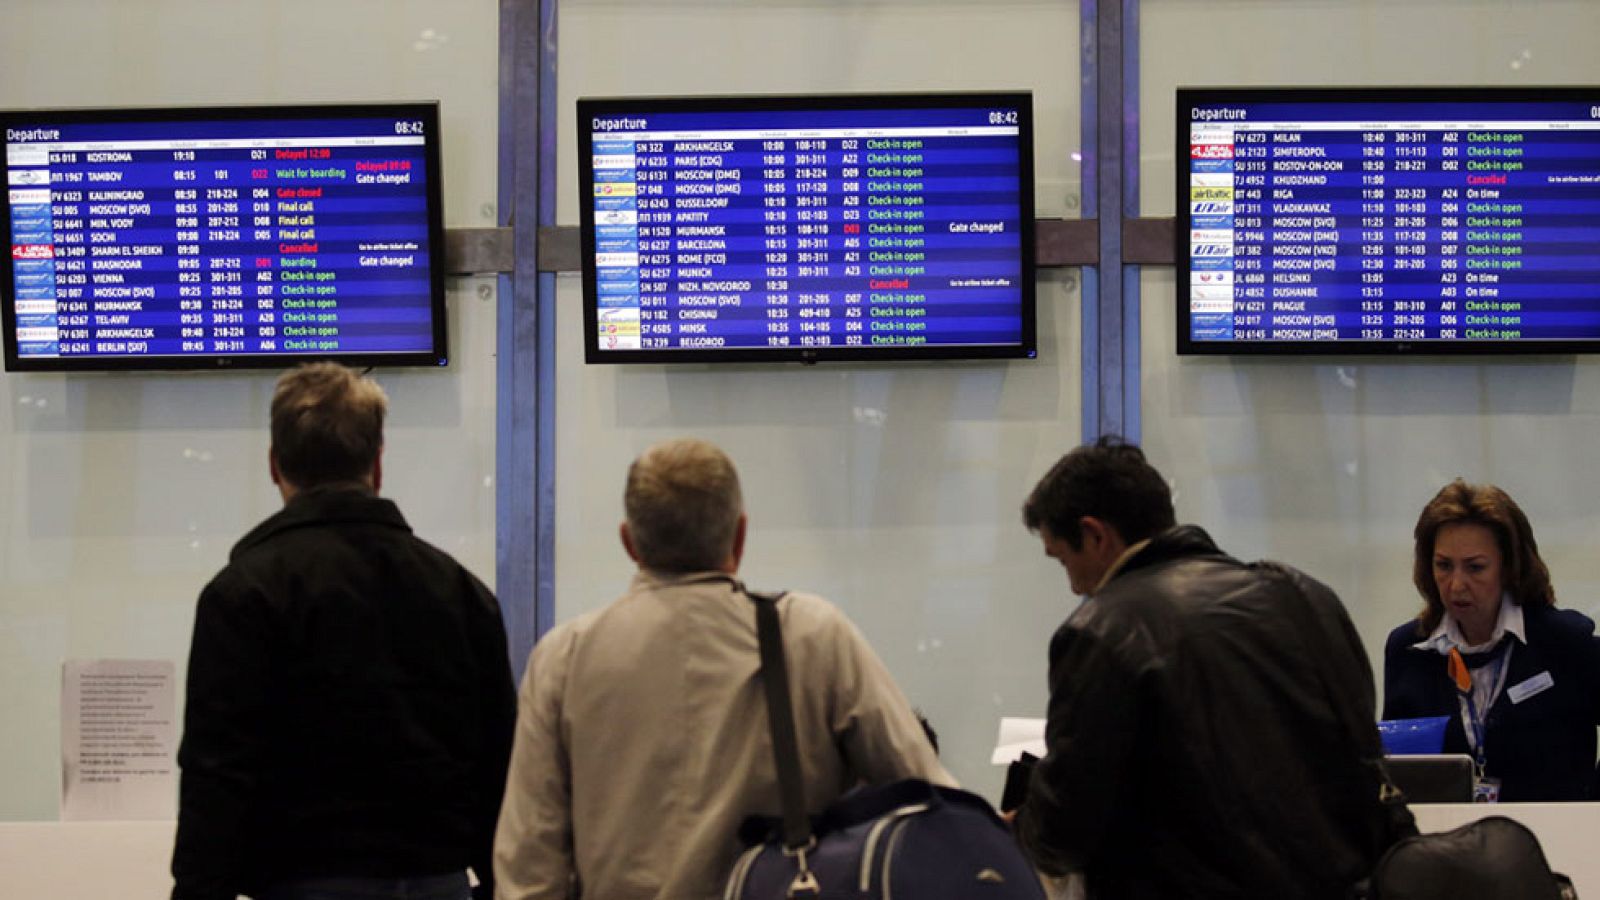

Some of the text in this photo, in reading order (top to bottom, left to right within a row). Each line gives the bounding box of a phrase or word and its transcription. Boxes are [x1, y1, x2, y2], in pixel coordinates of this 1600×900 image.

[989, 112, 1018, 124] 08:42
[1191, 108, 1247, 121] Departure
[395, 122, 423, 134] 08:42
[592, 118, 647, 131] Departure
[7, 129, 59, 142] Departure
[1233, 133, 1246, 143] FV
[1273, 133, 1301, 143] MILAN
[1363, 132, 1385, 143] 10:40
[1395, 132, 1426, 143] 301-311
[1442, 132, 1459, 143] A02
[1467, 132, 1502, 143] Check-in
[1502, 133, 1524, 143] open
[674, 141, 734, 152] ARKHANGELSK
[763, 141, 785, 151] 10:00
[842, 139, 858, 150] D22
[866, 139, 901, 150] Check-in
[901, 140, 923, 150] open
[1273, 146, 1326, 157] SIMFEROPOL
[87, 152, 132, 163] KOSTROMA
[251, 149, 267, 160] D21
[275, 149, 308, 160] Delayed
[674, 156, 698, 166] PARIS
[842, 153, 858, 164] A22
[866, 153, 901, 164] Check-in
[902, 154, 923, 164] open
[355, 161, 389, 172] Delayed
[1273, 160, 1523, 171] ROSTOV-ON-DON Check-in open
[87, 167, 346, 182] TAMBOV 101 Wait for boarding
[355, 173, 410, 184] Gate changed
[675, 169, 740, 181] MOSCOW (DME)
[1467, 175, 1507, 185] Cancelled
[675, 181, 923, 195] MOSCOW (DME) Check-in open
[1193, 189, 1231, 199] airBaltic
[1273, 188, 1500, 200] RIGA 11:00 322-323 A24 On time
[88, 188, 322, 201] KALININGRAD Gate closed
[89, 204, 128, 215] MOSCOW
[277, 201, 298, 212] Final
[298, 201, 314, 212] call
[675, 198, 728, 208] DUSSELDORF
[1273, 202, 1523, 214] VLADIKAVKAZ Check-in open
[868, 209, 902, 220] Check-in
[902, 210, 924, 220] open
[90, 219, 110, 228] MIN.
[278, 215, 299, 226] Final
[298, 215, 314, 226] call
[1273, 217, 1312, 228] MOSCOW
[676, 221, 1004, 236] MURMANSK Gate changed
[90, 229, 315, 243] SOCHI Final call
[1273, 231, 1522, 242] MOSCOW (DME) Check-in open
[91, 243, 318, 256] SHARM EL SHEIKH Cancelled
[677, 237, 925, 250] BARCELONA Check-in open
[1273, 245, 1312, 256] MOSCOW
[92, 255, 413, 270] KRASNODAR Boarding Gate changed
[677, 254, 703, 264] ROME
[1273, 259, 1312, 270] MOSCOW
[92, 270, 336, 284] VIENNA Check-in open
[678, 265, 925, 278] MUNICH Check-in open
[1273, 272, 1499, 283] HELSINKI 13:05 A23 On time
[94, 287, 131, 298] MOSCOW
[281, 285, 315, 295] Check-in
[316, 286, 337, 295] open
[678, 279, 909, 292] NIZH. NOVGOROD Cancelled
[1465, 286, 1478, 297] On
[1478, 287, 1498, 297] time
[94, 298, 337, 311] MURMANSK Check-in open
[678, 295, 717, 306] MOSCOW
[869, 293, 904, 303] Check-in
[904, 294, 926, 304] open
[1273, 300, 1521, 312] PRAGUE Check-in open
[1273, 315, 1312, 326] MOSCOW
[95, 326, 338, 339] ARKHANGELSK Check-in open
[679, 323, 706, 333] MINSK
[1273, 329, 1338, 340] MOSCOW (DME)
[96, 342, 126, 352] BERLIN
